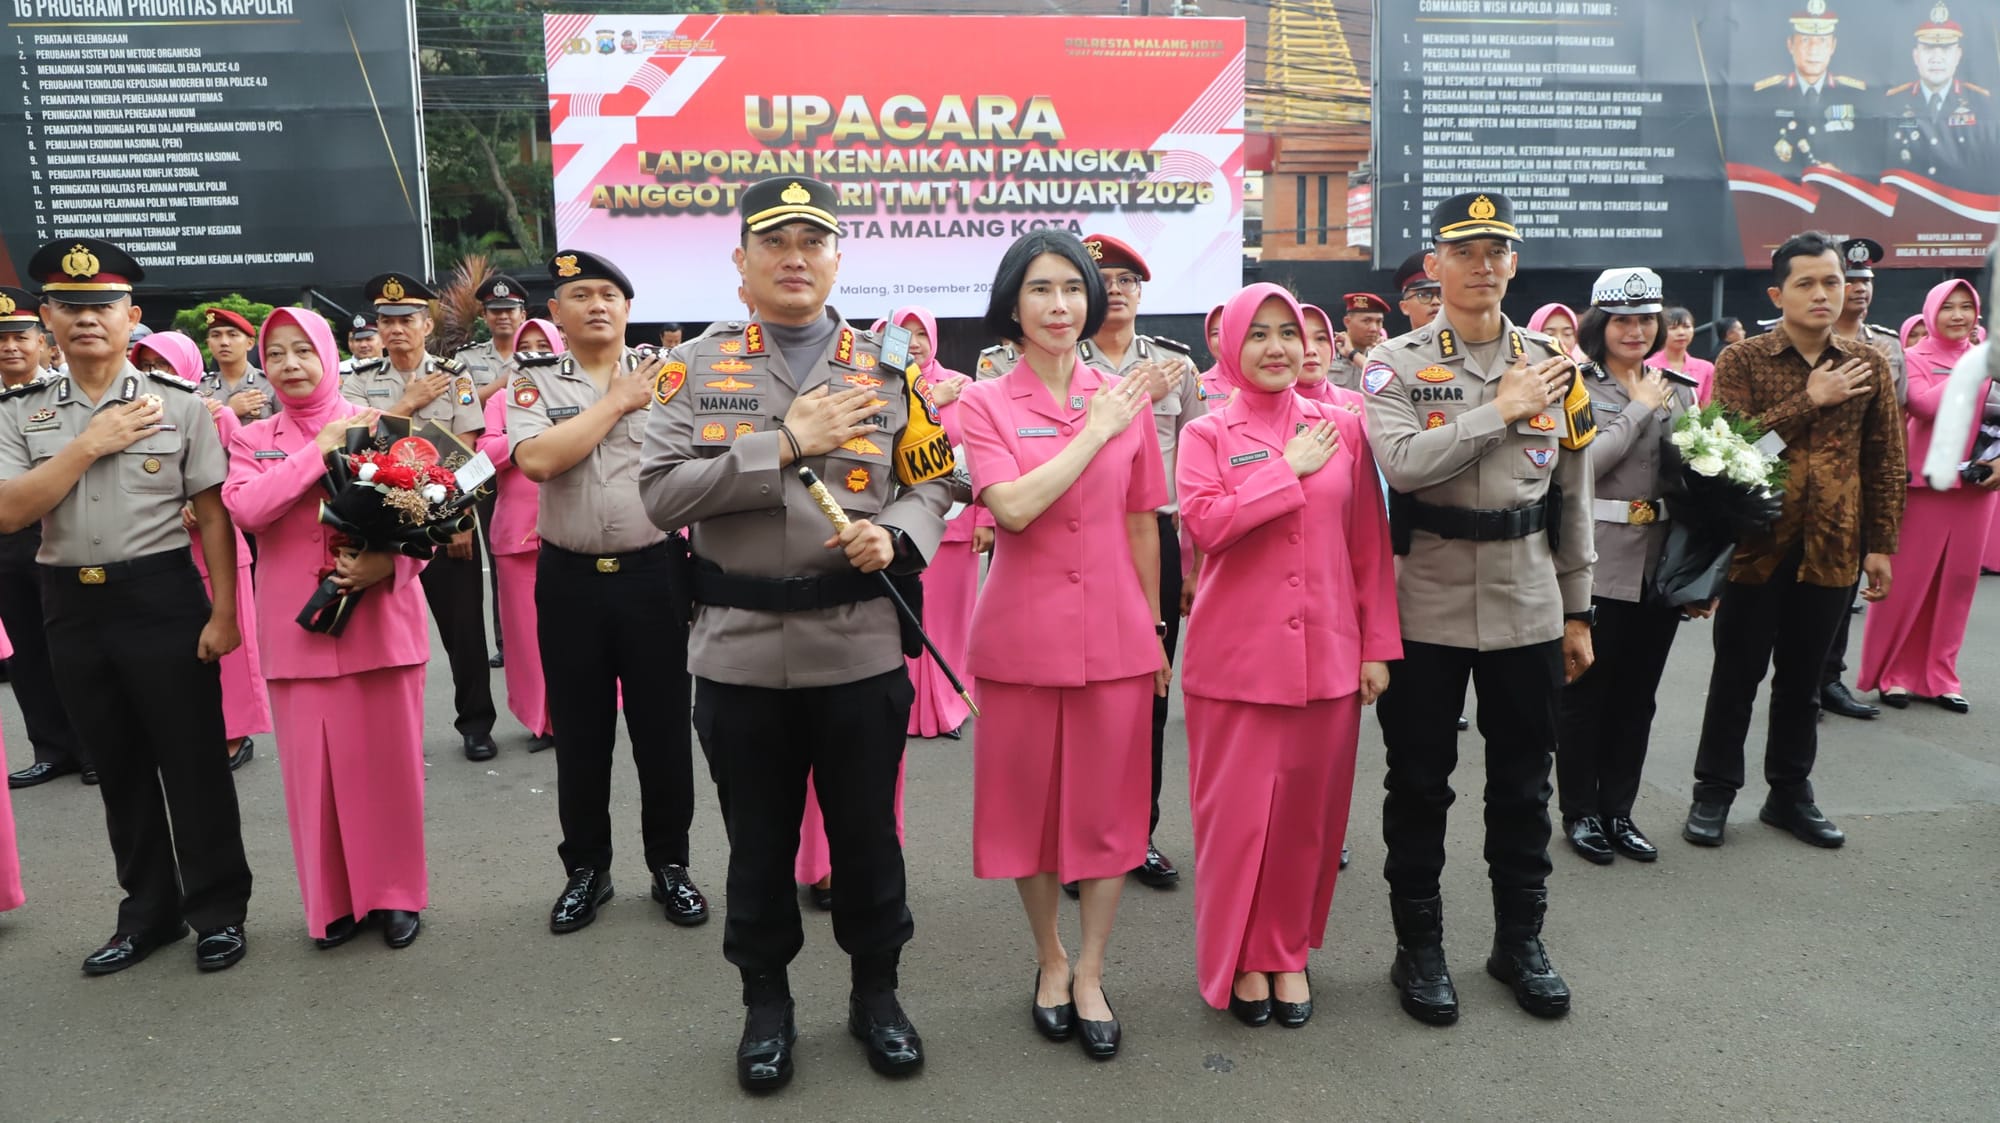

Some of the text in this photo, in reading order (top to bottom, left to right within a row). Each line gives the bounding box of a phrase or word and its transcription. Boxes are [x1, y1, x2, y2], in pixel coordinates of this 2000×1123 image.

[14, 0, 293, 17] 16 PROGRAM PRIORITAS KAPOLRI
[1420, 0, 1612, 15] COMMANDER WISH KAPOLDA JAWA TIMUR
[33, 34, 129, 44] PENATAAN KELEMBAGAAN
[35, 48, 202, 60] PERUBAHAN SISTEM DAN METODE ORGANISASI
[37, 62, 240, 75] MENJADIKAN SDM POLRI YANG UNGGUL DI ERA POLICE 4.0
[38, 77, 268, 90] PERUBAHAN TEKNOLOGI KEPOLISIAN MODEREN DI ERA POLICE 4.0
[40, 92, 224, 105] PEMANTAPAN KINERJA PEMELIHARAAN KAMTIBMAS
[41, 108, 196, 120] PENINGKATAN KINERJA PENEGAKAN HUKUM
[745, 94, 1066, 142] UPACARA
[43, 121, 283, 135] PEMANTAPAN DUKUNGAN POLRI DALAM PENANGANAN COVID 19 (PC)
[45, 138, 183, 150] PEMULIHAN EKONOMI NASIONAL (PEN)
[46, 152, 241, 165] MENJAMIN KEAMANAN PROGRAM PRIORITAS NASIONAL
[638, 149, 1168, 175] LAPORAN KENAIKAN PANGKAT
[48, 168, 200, 179] PENGUATAN PENANGANAN KONFLIK SOSIAL
[49, 181, 227, 194] PENINGKATAN KUALITAS PELAYANAN PUBLIK POLRI
[588, 183, 742, 209] ANGGOT
[880, 182, 952, 206] TMT
[958, 182, 971, 206] 1
[978, 181, 1129, 206] JANUARI
[1136, 181, 1215, 205] 2026
[51, 196, 239, 209] MEWUJUDKAN PELAYANAN POLRI YANG TERINTEGRASI
[53, 212, 177, 224] PEMANTAPAN KOMUNIKASI PUBLIK
[54, 225, 242, 239] PENGAWASAN PIMPINAN TERHADAP SETIAP KEGIATAN
[890, 218, 1005, 239] MALANG
[126, 241, 177, 252] PENGAWASAN
[135, 252, 314, 266] ASYARAKAT PENCARI KEADILAN (PUBLIC COMPLAIN)
[840, 283, 995, 297] Malang, 31 Desember 202
[1411, 386, 1464, 403] OSKAR
[700, 396, 759, 412] NANANG
